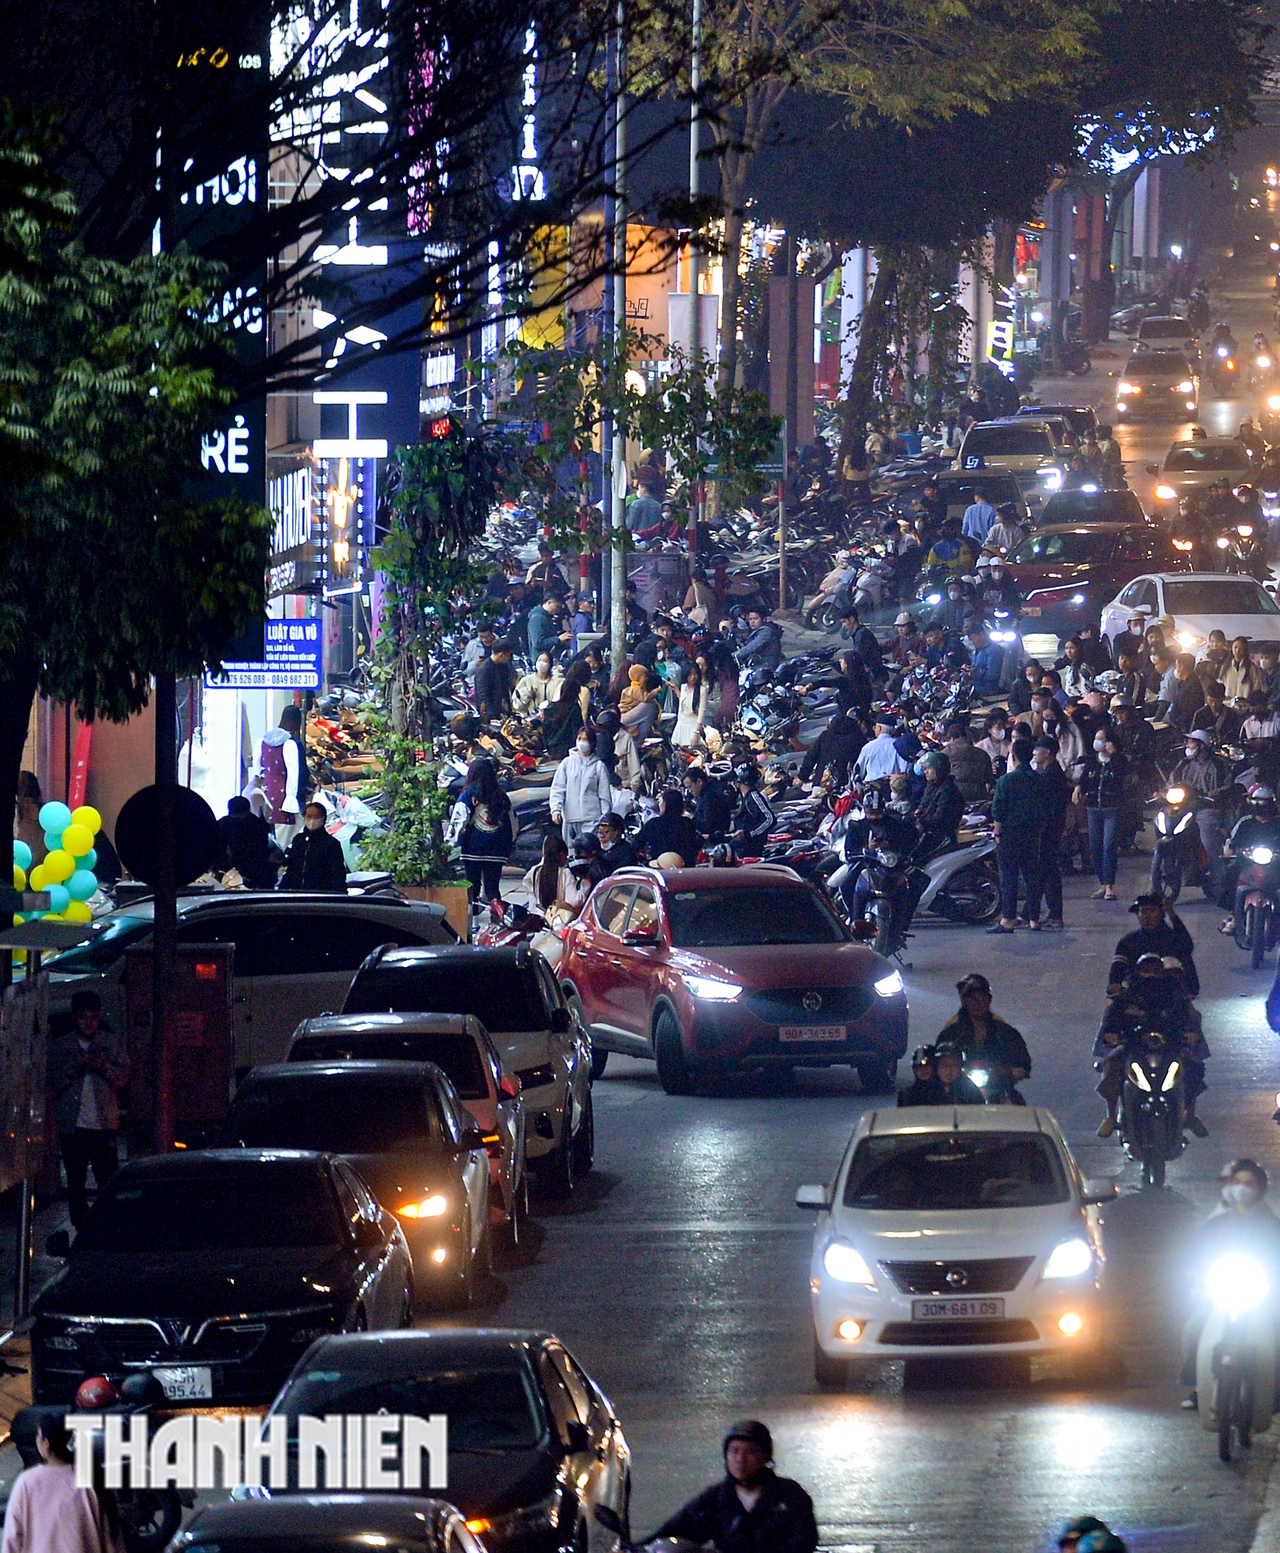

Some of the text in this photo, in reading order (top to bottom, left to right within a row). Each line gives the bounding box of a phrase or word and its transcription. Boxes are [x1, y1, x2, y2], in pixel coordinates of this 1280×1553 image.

[267, 622, 317, 643] LUẬT GIA VŨ
[240, 674, 251, 685] 626
[290, 674, 301, 685] 682
[304, 674, 316, 685] 311
